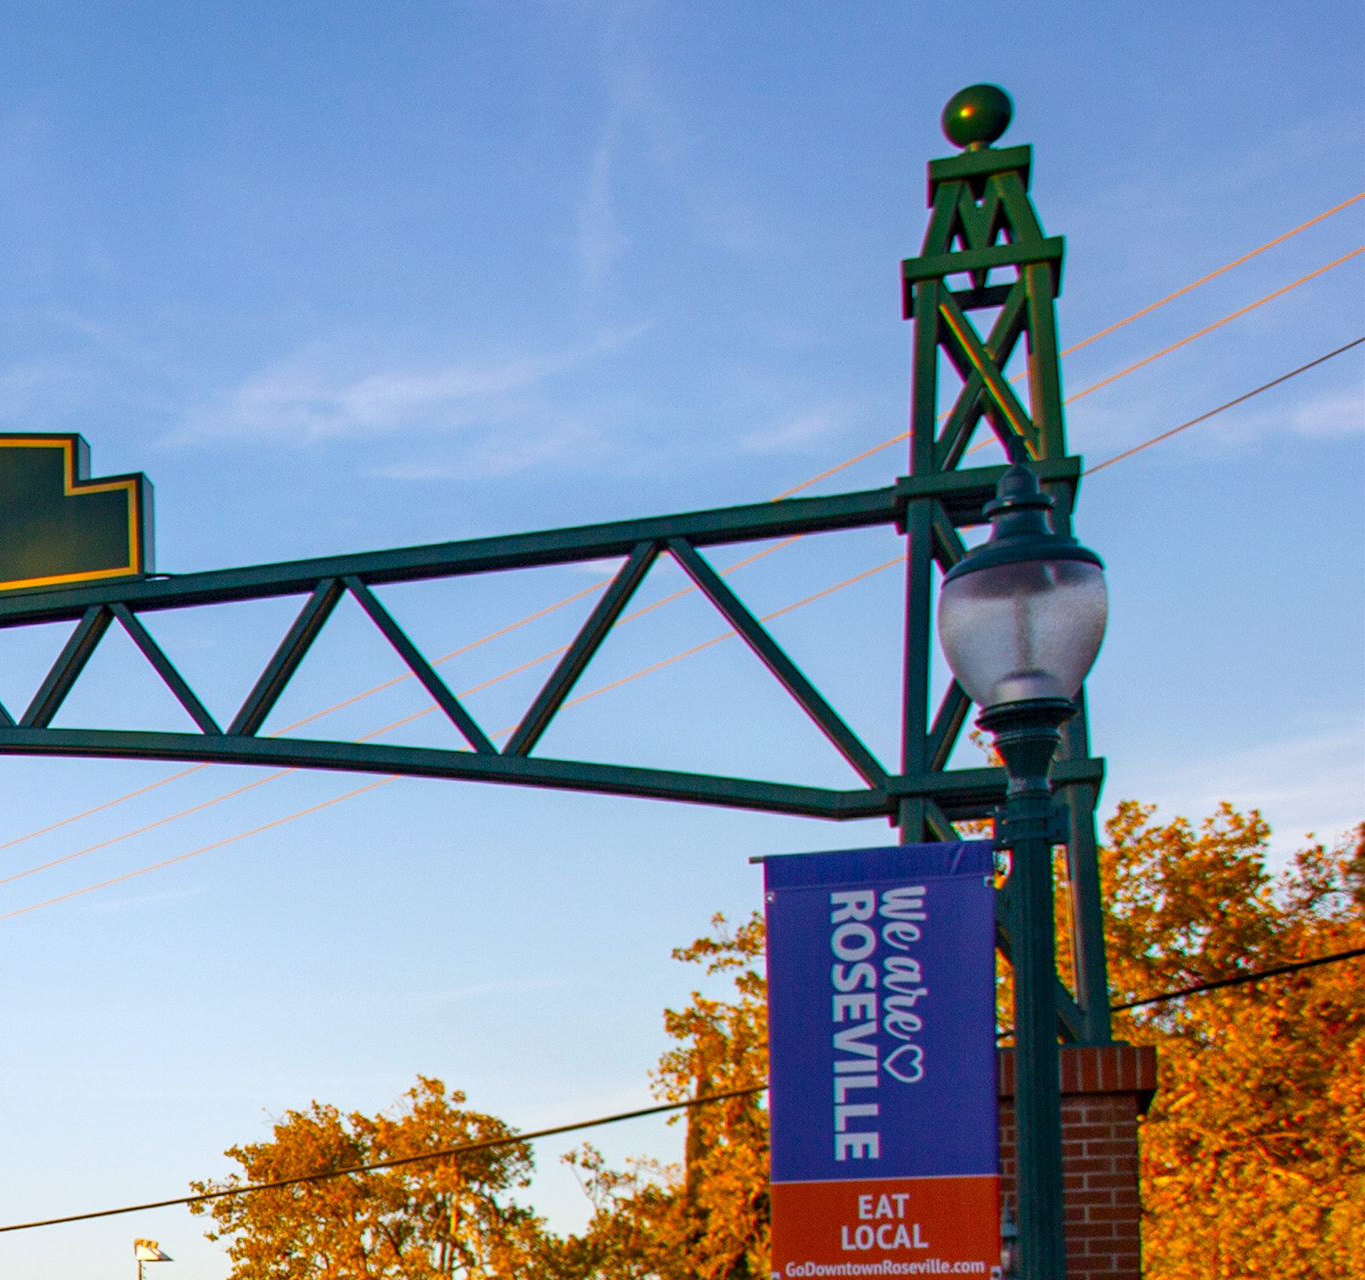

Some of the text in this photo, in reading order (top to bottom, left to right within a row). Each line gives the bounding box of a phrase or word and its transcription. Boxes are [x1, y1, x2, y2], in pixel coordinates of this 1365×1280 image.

[882, 956, 929, 1041] are
[830, 889, 880, 1161] ROSEVILLE
[858, 1193, 910, 1220] EAT
[841, 1224, 929, 1250] LOCAL
[785, 1258, 985, 1277] GoDowntownRoseville.com
